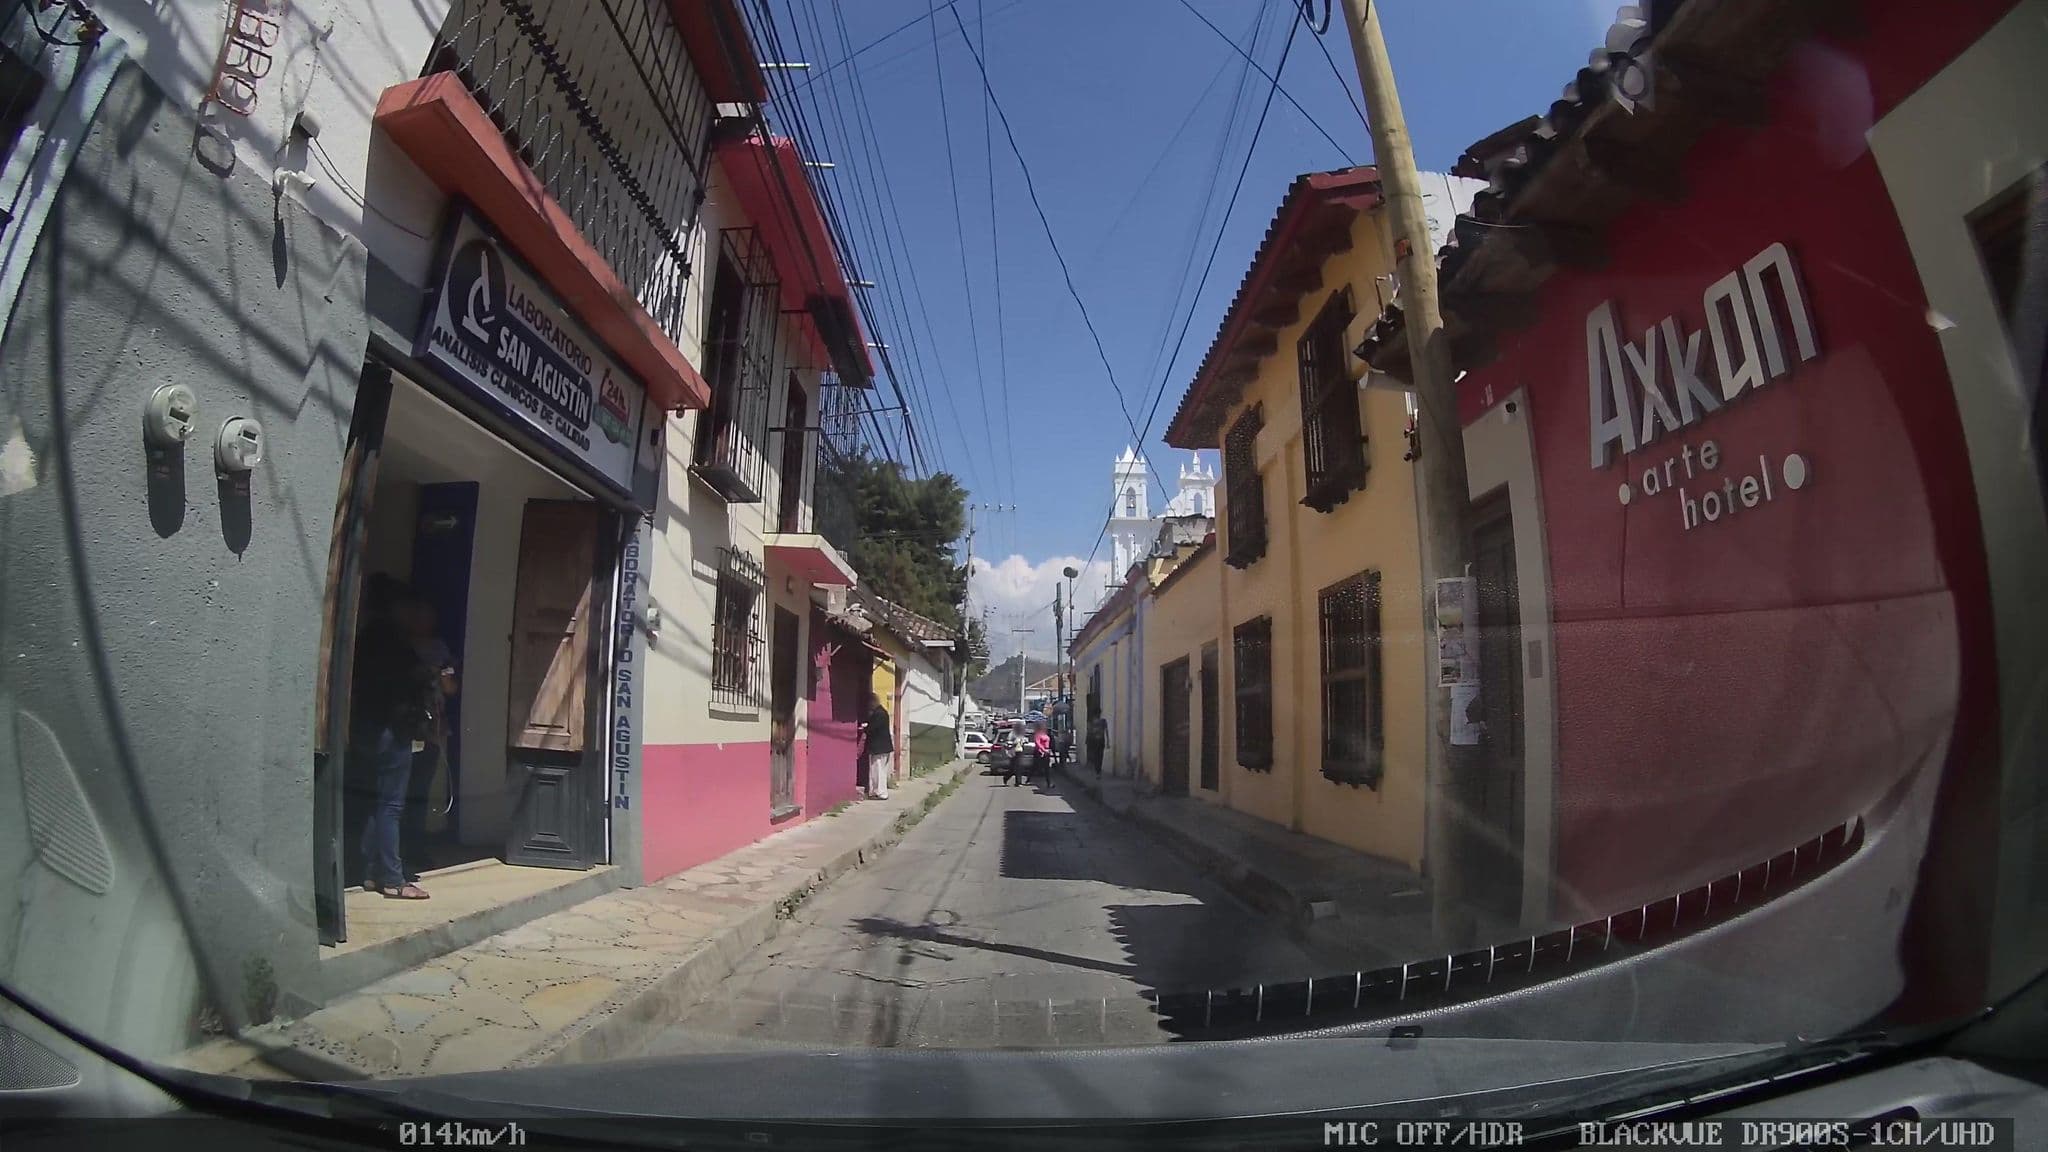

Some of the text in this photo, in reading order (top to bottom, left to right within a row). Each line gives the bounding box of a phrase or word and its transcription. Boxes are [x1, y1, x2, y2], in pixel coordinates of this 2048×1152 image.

[497, 326, 589, 423] SAN AGUSTÍN
[508, 284, 592, 375] LABORATORIO
[1586, 241, 1819, 469] Axkan
[541, 404, 554, 425] DE
[555, 416, 590, 451] CALIDAD
[1643, 440, 1719, 496] arte
[1680, 454, 1772, 530] hotel
[615, 529, 641, 810] ABORATORIO SAN AGUSTIN
